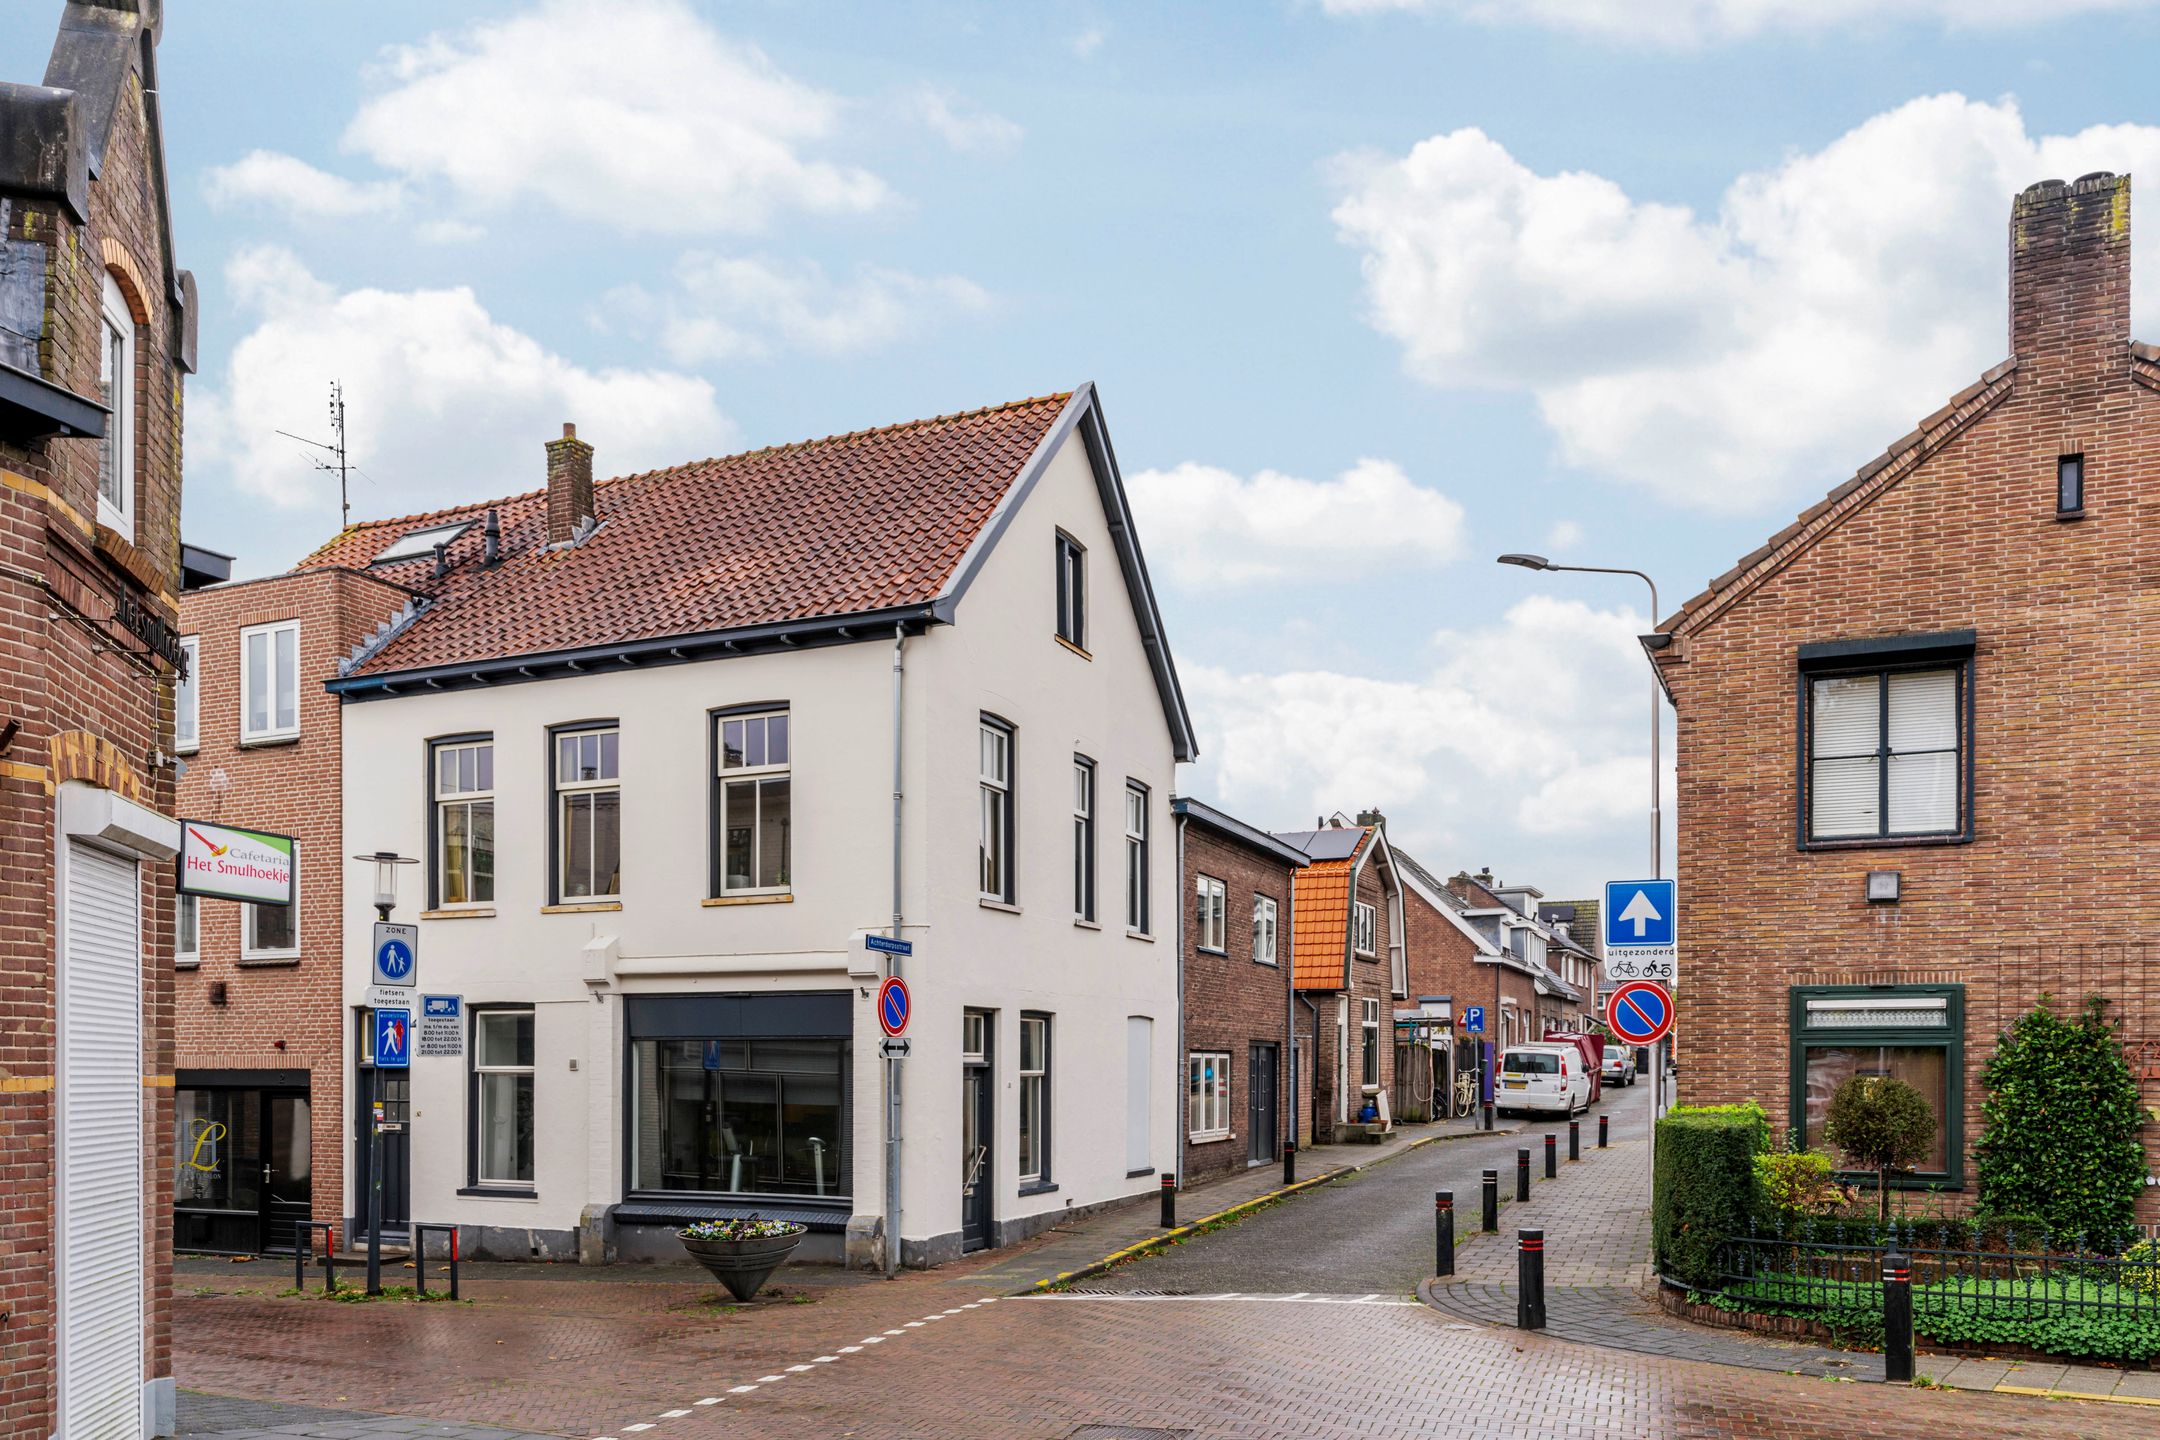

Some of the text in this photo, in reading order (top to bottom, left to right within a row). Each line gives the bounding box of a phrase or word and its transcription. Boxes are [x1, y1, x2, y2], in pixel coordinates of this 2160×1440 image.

[229, 848, 290, 866] Cafetaria
[187, 855, 290, 884] Het Smulhoekje
[385, 926, 407, 935] ZONE
[1608, 948, 1675, 958] uitgezonderd
[374, 998, 410, 1006] toegestaan
[1470, 1009, 1480, 1021] P
